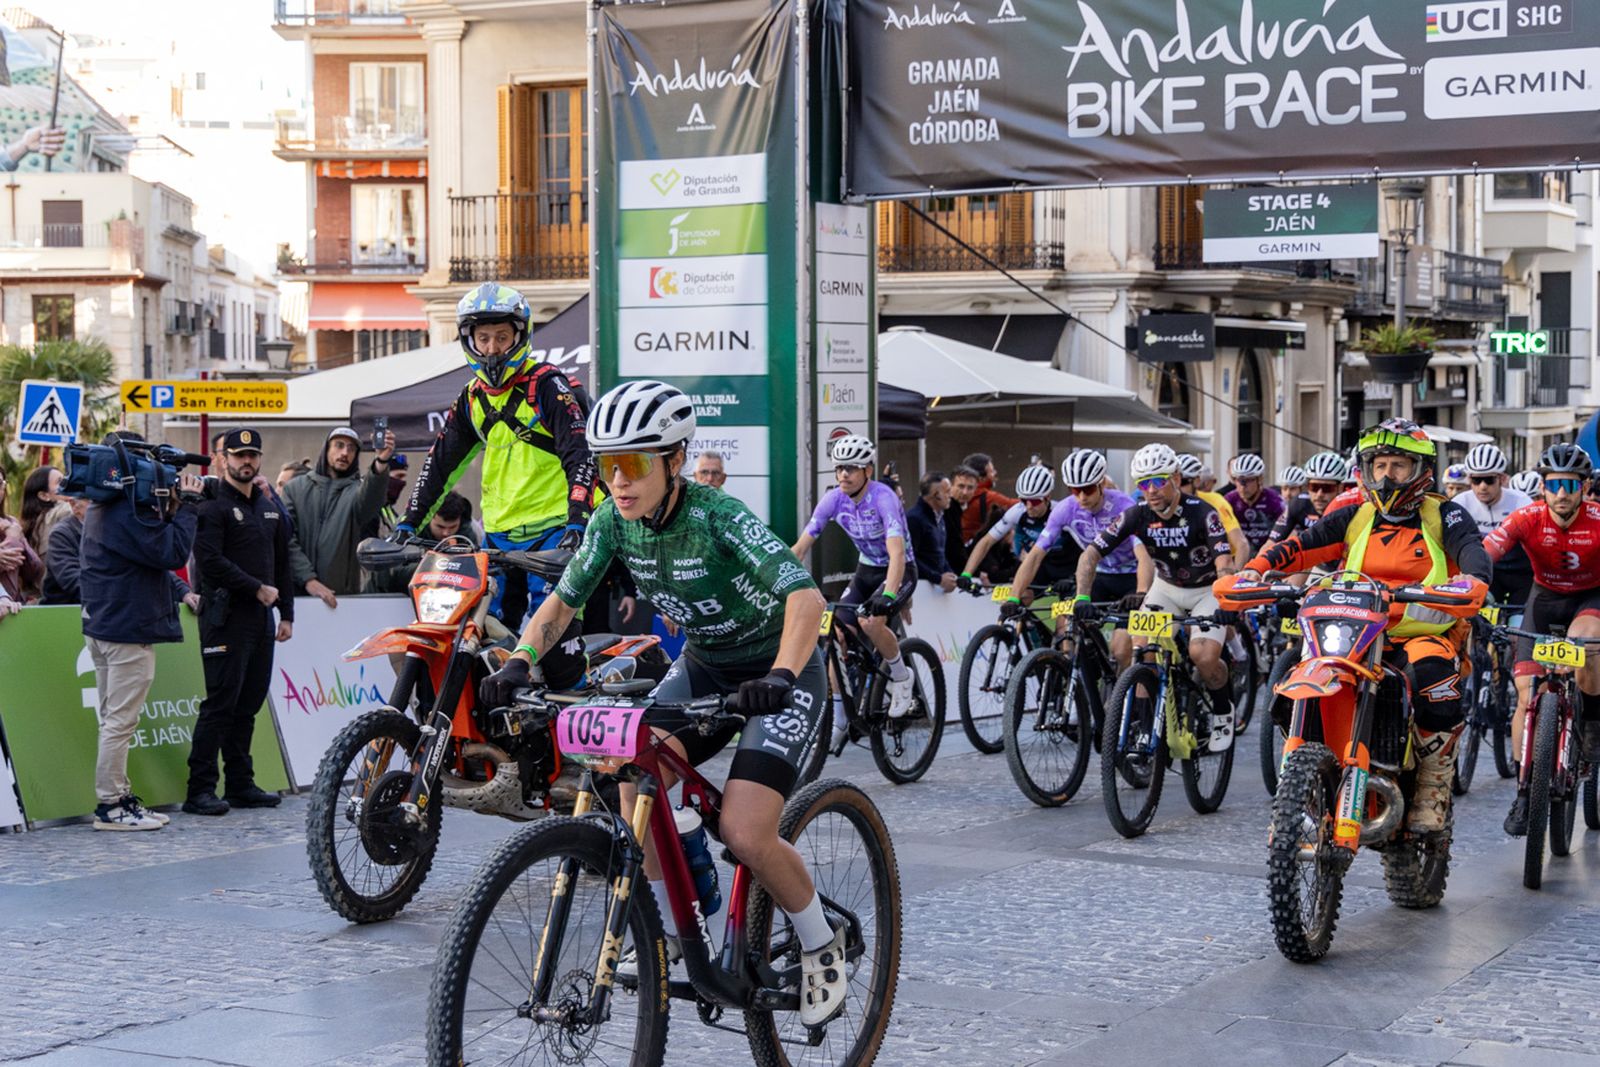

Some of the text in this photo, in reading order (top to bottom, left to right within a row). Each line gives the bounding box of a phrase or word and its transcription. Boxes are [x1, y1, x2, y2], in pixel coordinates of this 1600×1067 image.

[883, 2, 976, 30] Andalucía
[1441, 5, 1562, 34] UCI SHC
[1061, 0, 1406, 79] Andalucía
[629, 53, 761, 97] Andalucía
[908, 56, 1000, 85] GRANADA
[1445, 69, 1586, 98] GARMIN
[928, 84, 980, 114] JAÉN
[1067, 63, 1424, 138] BIKE RACE BY
[909, 116, 1000, 145] CÓRDOBA
[683, 174, 738, 188] Diputación
[683, 184, 741, 197] de Granada
[1248, 192, 1332, 211] STAGE 4
[1264, 212, 1316, 232] JAÉN
[1258, 242, 1321, 254] GARMIN
[683, 271, 735, 284] Diputación
[683, 284, 735, 295] de Córdoba
[820, 279, 864, 297] GARMIN
[634, 330, 752, 352] GARMIN
[1490, 332, 1547, 353] TRIC
[155, 387, 172, 406] P
[181, 386, 283, 394] aparcamiento municipal
[704, 394, 739, 405] RURAL
[831, 384, 855, 404] Jaén
[179, 397, 284, 408] San Francisco
[689, 440, 739, 449] ENTIFFIC
[1153, 536, 1187, 548] TEAM
[1315, 607, 1369, 618] ORGANIZACIÓN
[1132, 612, 1168, 634] 320-1
[1537, 643, 1579, 662] 316-1
[280, 664, 388, 716] Andalucía
[138, 694, 207, 720] PUTACIÓ
[128, 723, 193, 749] DE JAÉN
[567, 709, 633, 748] 105-1
[431, 727, 449, 767] MOTOREX
